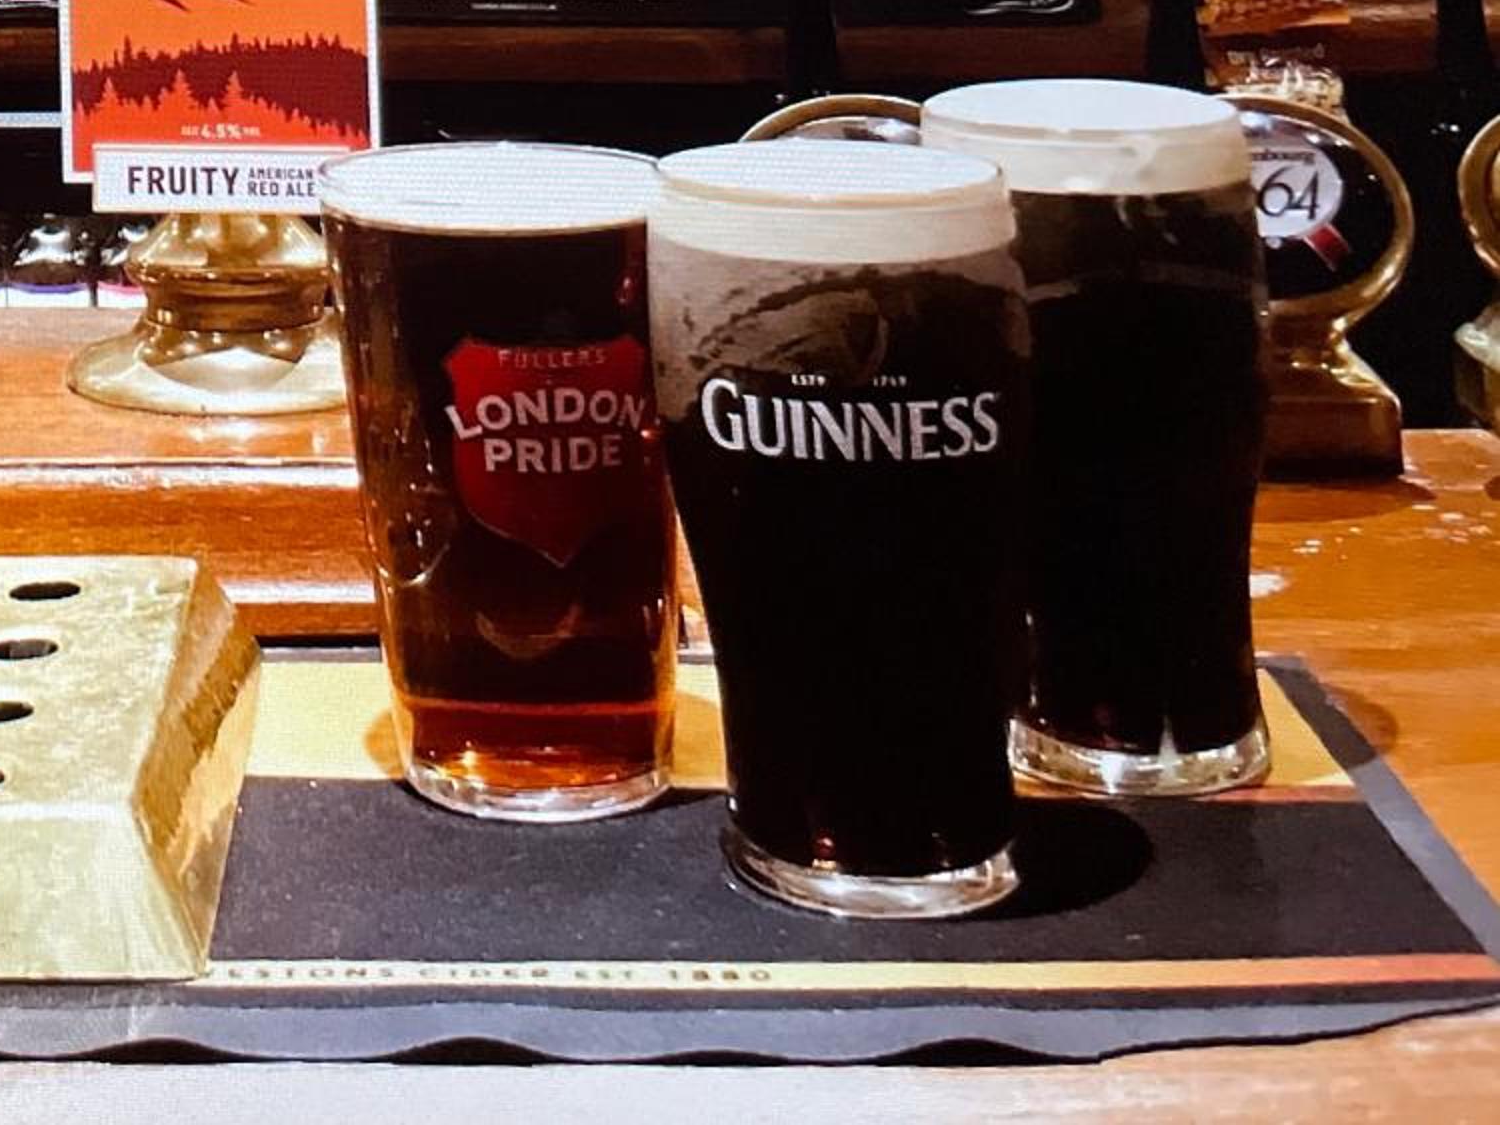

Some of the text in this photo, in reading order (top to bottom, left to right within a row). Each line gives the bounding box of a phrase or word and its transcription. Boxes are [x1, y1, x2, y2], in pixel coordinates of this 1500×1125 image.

[127, 165, 314, 198] FRUITY AMERICAN
[248, 182, 317, 198] RED ALE
[444, 387, 646, 441] LONDON
[701, 376, 1000, 463] GUINNESS
[483, 434, 624, 474] PRIDE
